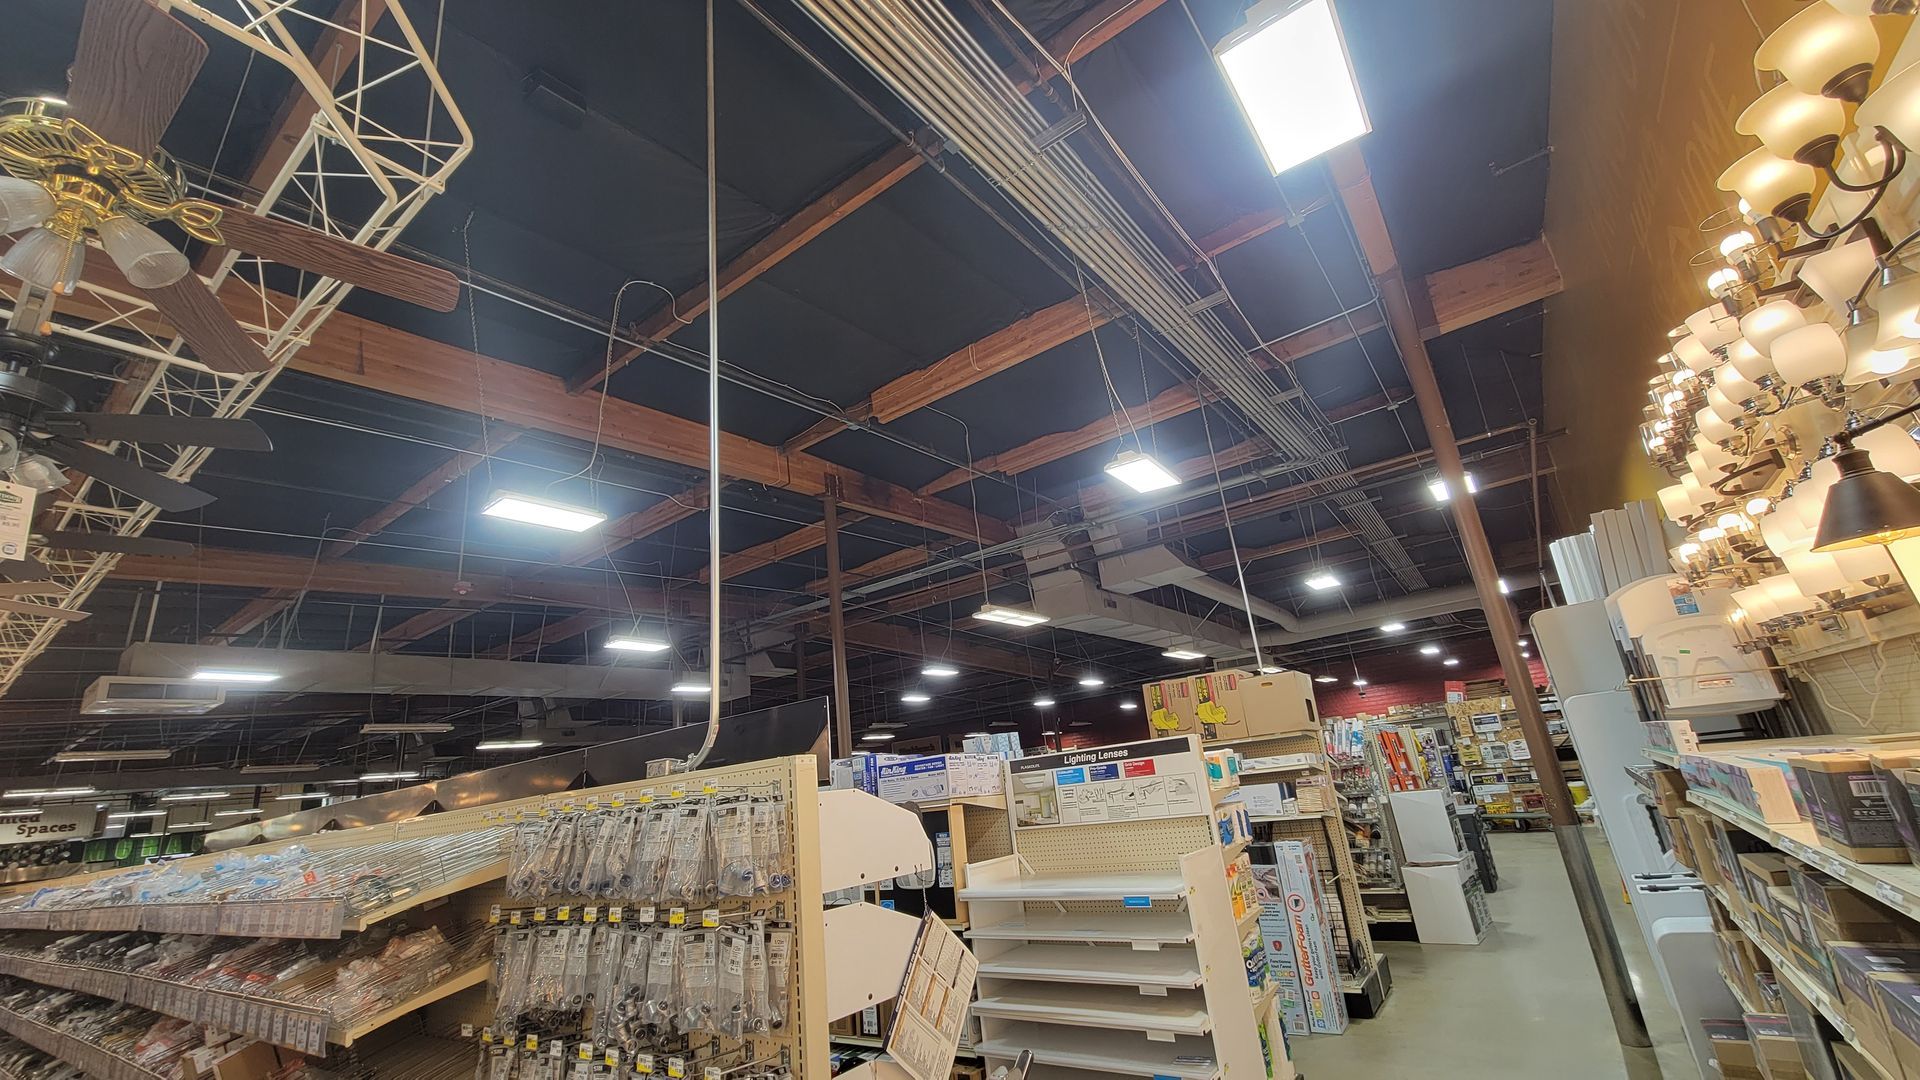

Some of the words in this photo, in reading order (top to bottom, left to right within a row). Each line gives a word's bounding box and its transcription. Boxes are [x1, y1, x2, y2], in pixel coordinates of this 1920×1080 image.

[1064, 754, 1097, 765] Lighting
[1098, 749, 1129, 760] Lenses
[16, 823, 77, 837] Spaces
[1294, 915, 1315, 986] GutterFoam
